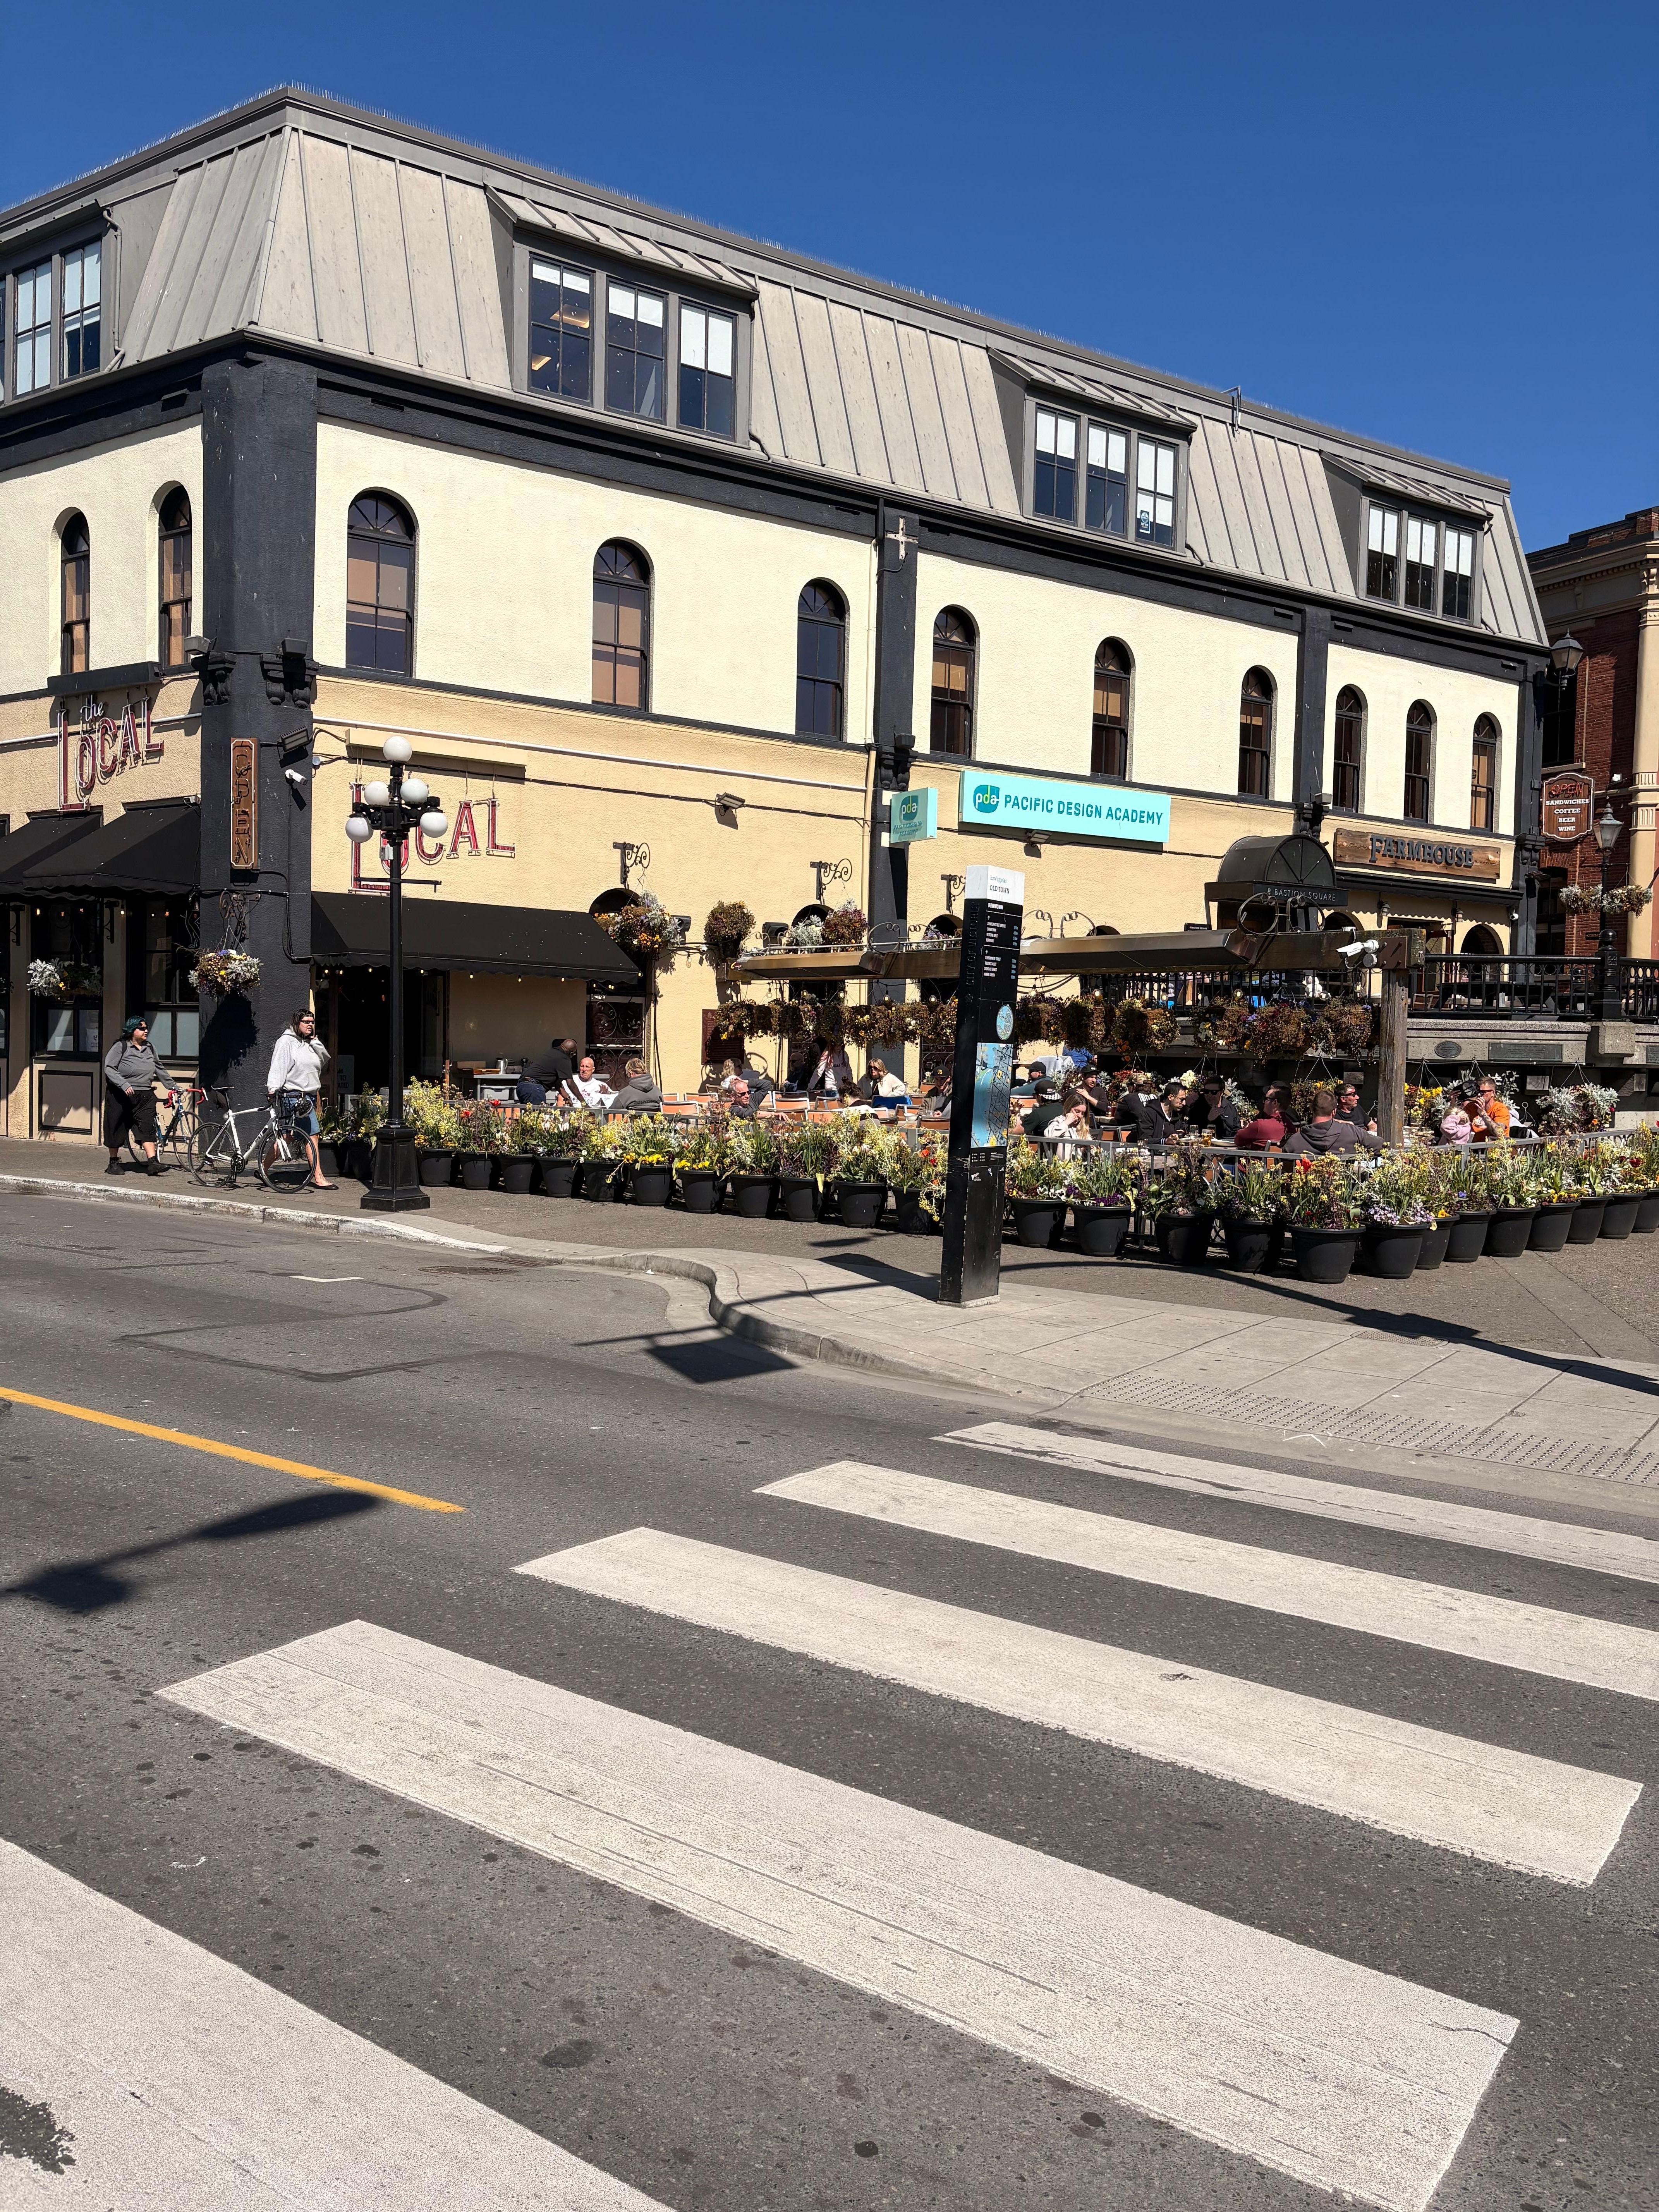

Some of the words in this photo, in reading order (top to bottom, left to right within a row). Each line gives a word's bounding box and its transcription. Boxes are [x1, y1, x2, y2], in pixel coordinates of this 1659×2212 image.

[80, 694, 104, 722] the
[57, 696, 164, 812] LOCAL
[1551, 781, 1584, 795] OPEN
[901, 795, 917, 819] pda
[976, 785, 999, 809] pda
[1004, 794, 1053, 813] PACIFIC
[1058, 800, 1102, 819] DESIGN
[1106, 806, 1163, 825] ACADEMY
[1369, 834, 1474, 869] FARMHOUSE
[1274, 889, 1305, 898] BASTION
[1309, 892, 1336, 901] SQUARE
